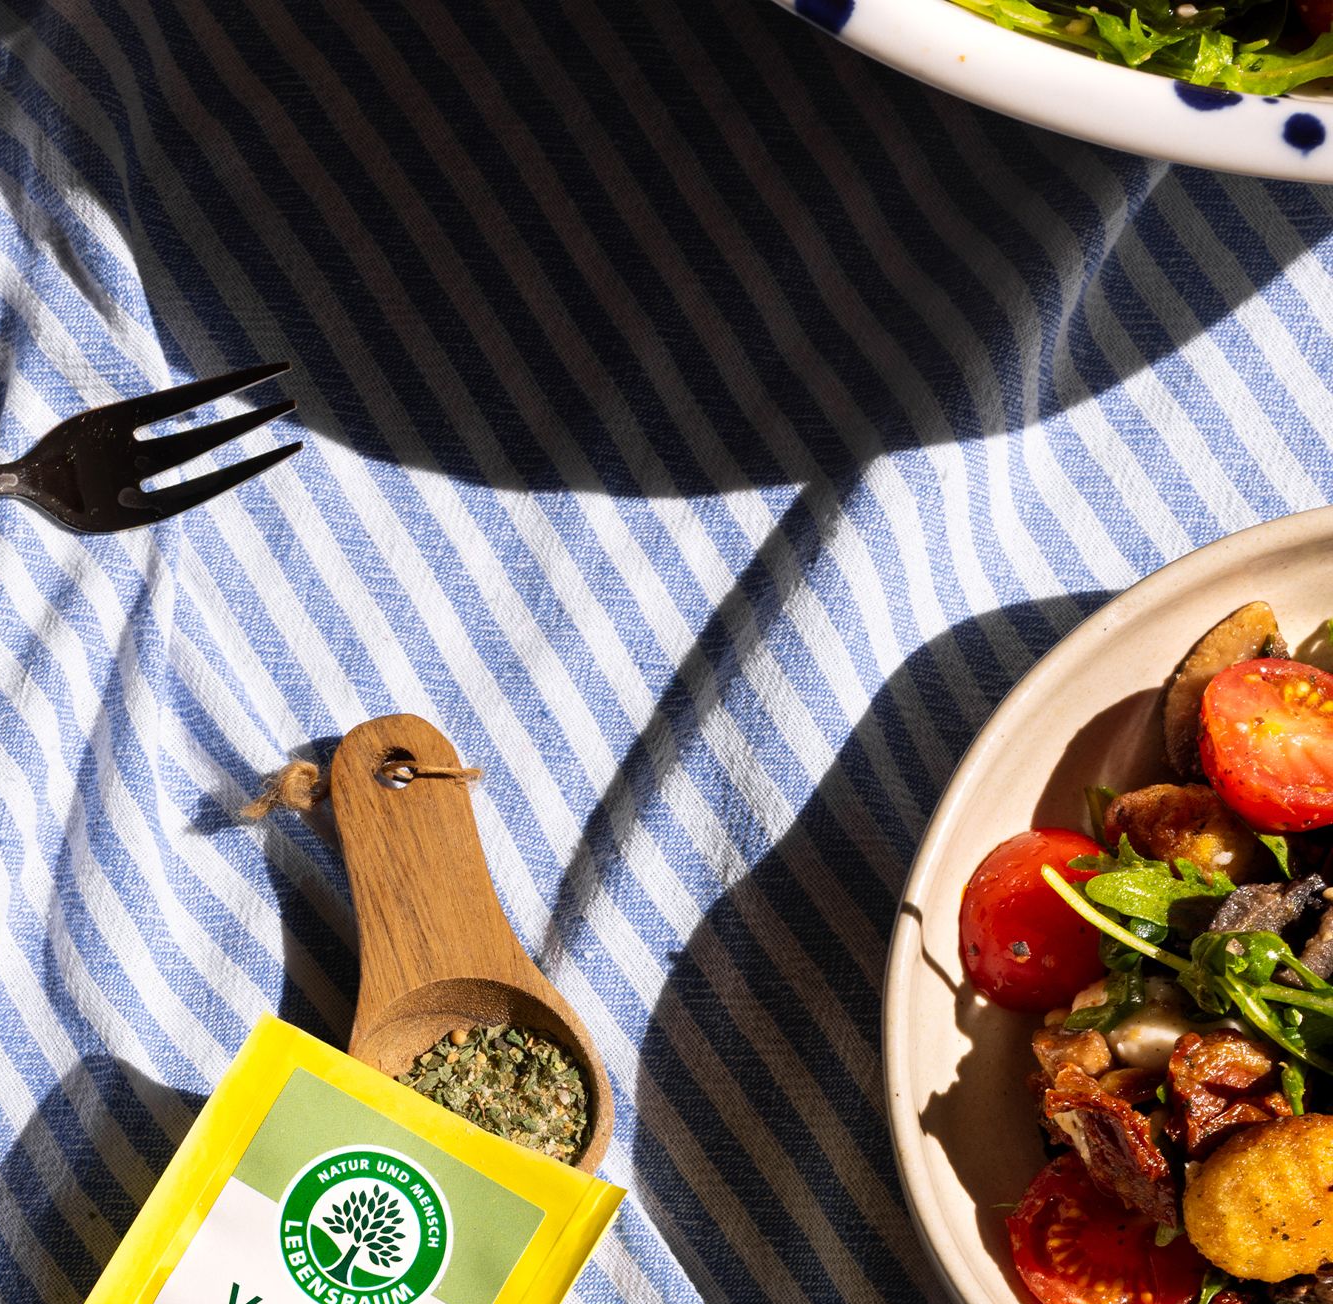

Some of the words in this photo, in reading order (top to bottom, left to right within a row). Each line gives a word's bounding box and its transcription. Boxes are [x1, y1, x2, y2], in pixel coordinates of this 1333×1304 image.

[317, 1159, 369, 1184] NATUR
[376, 1160, 410, 1184] UND
[410, 1183, 439, 1248] MENSCH
